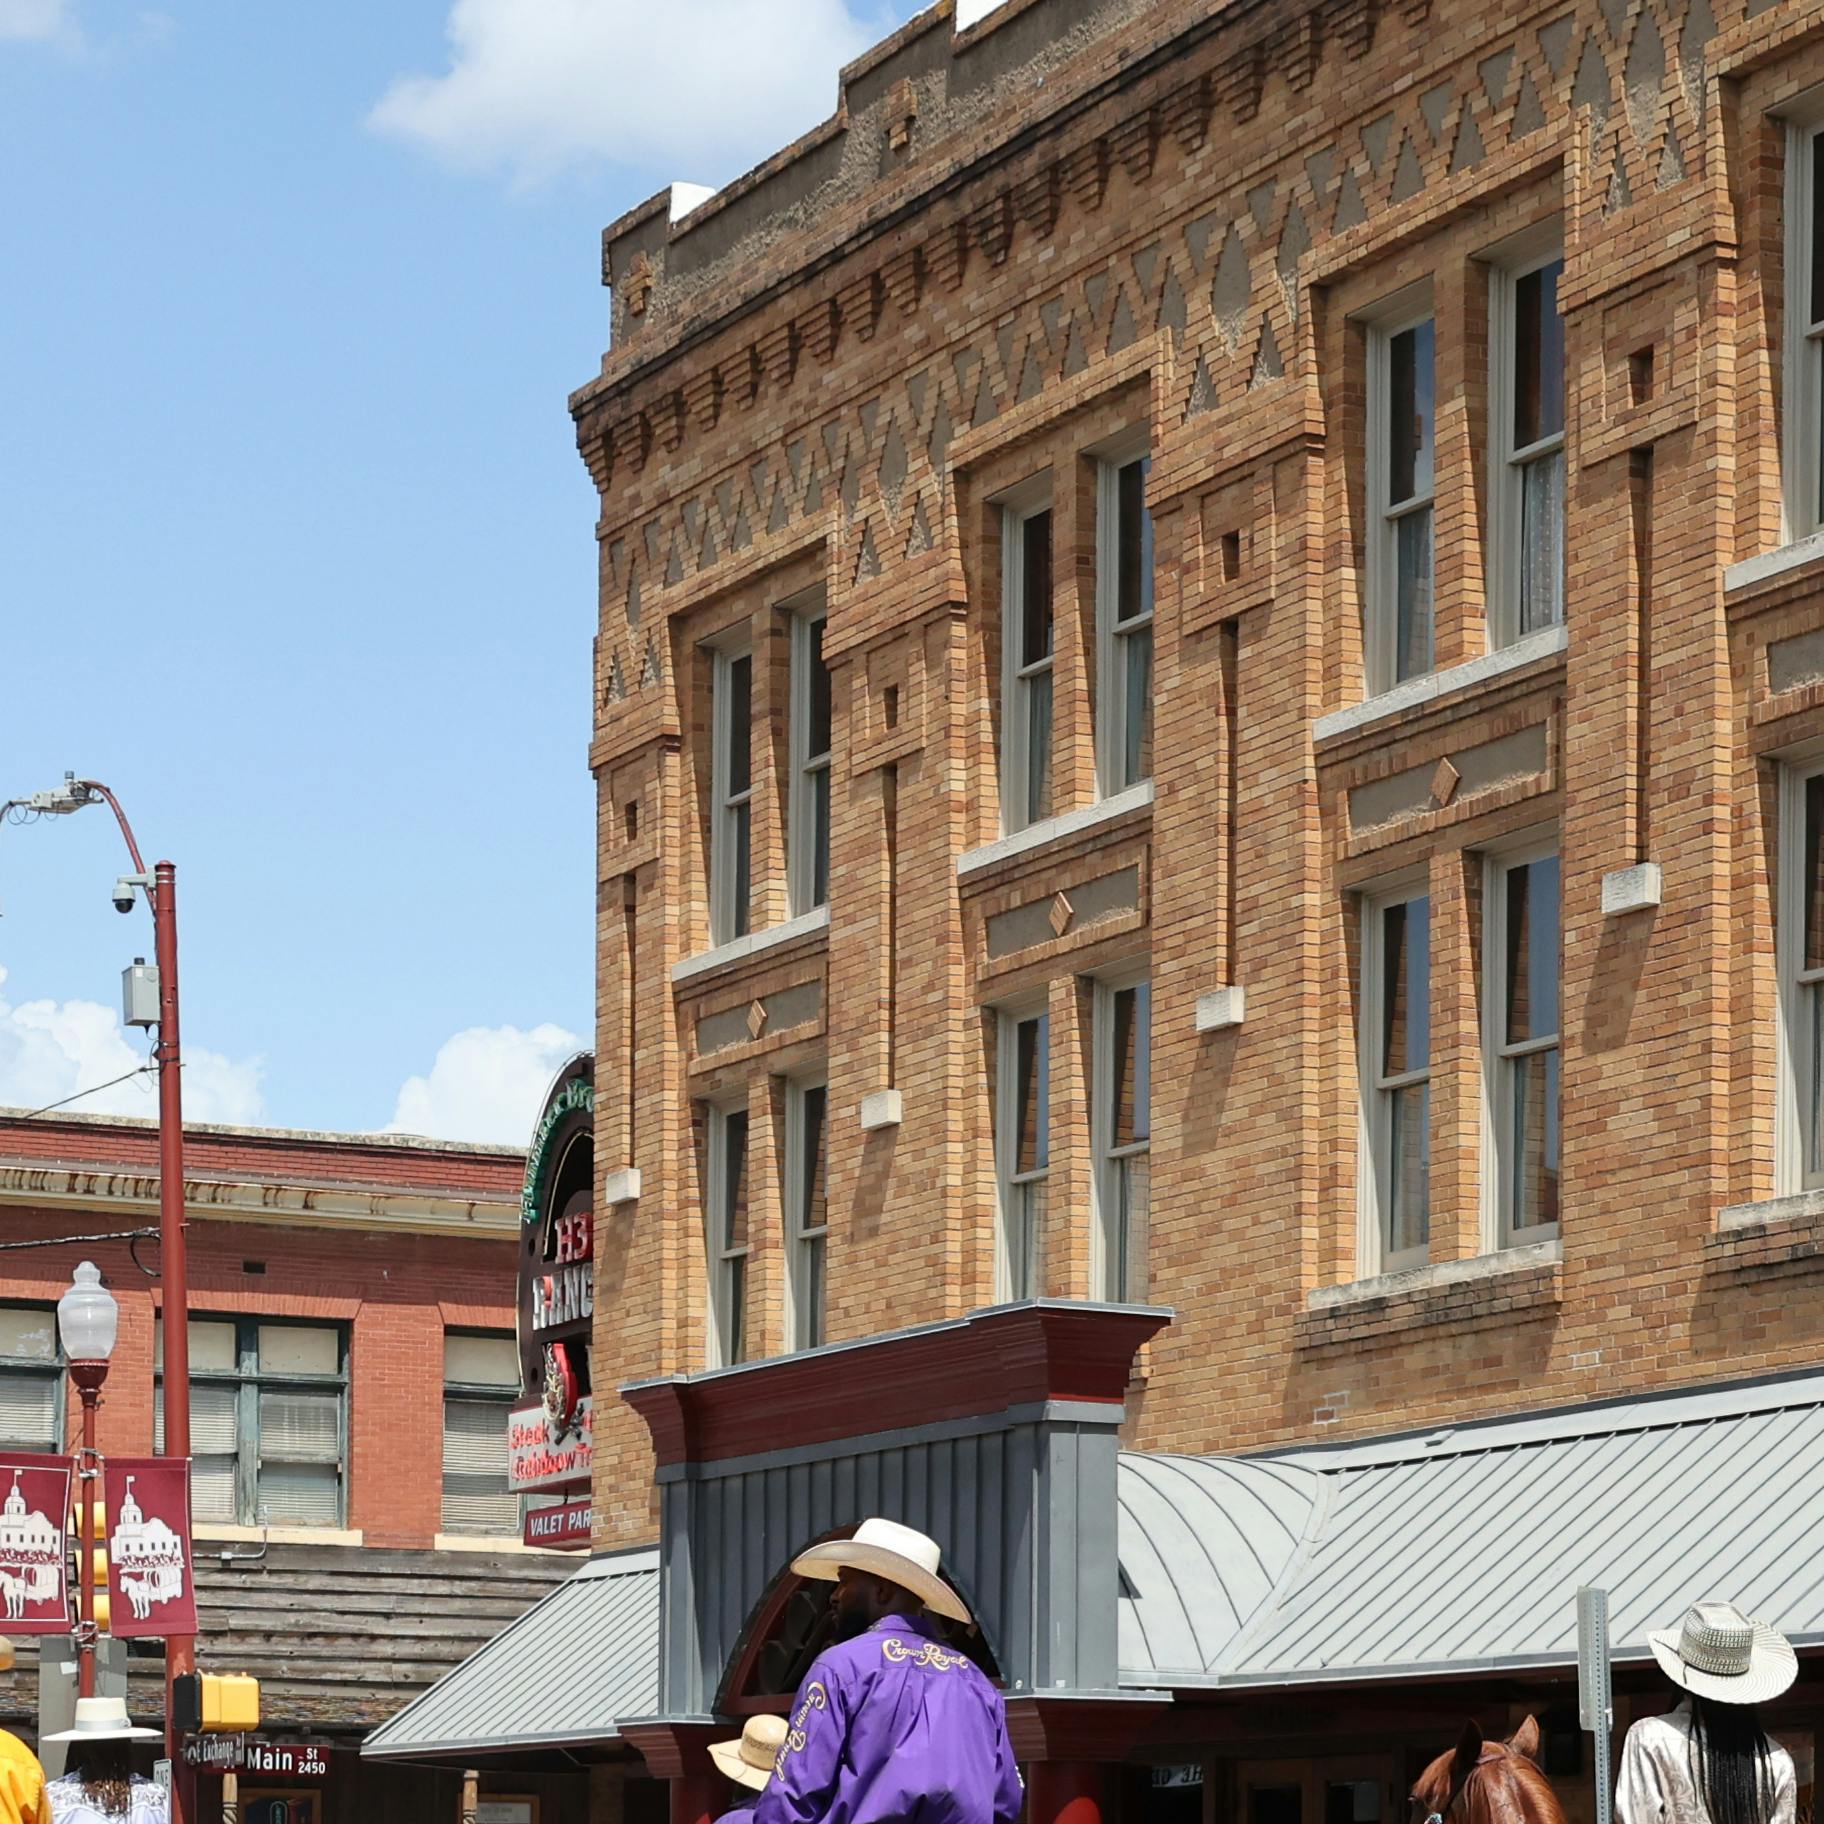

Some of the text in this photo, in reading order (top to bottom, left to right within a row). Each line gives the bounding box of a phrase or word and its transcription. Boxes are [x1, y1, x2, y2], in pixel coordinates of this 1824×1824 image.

[533, 1264, 593, 1330] RANC
[531, 1510, 592, 1537] VALET PAR
[882, 1638, 969, 1671] Crown Royal
[796, 1681, 826, 1727] Crown
[203, 1737, 234, 1764] Exchange
[247, 1748, 318, 1770] Main St
[298, 1762, 326, 1774] 2450
